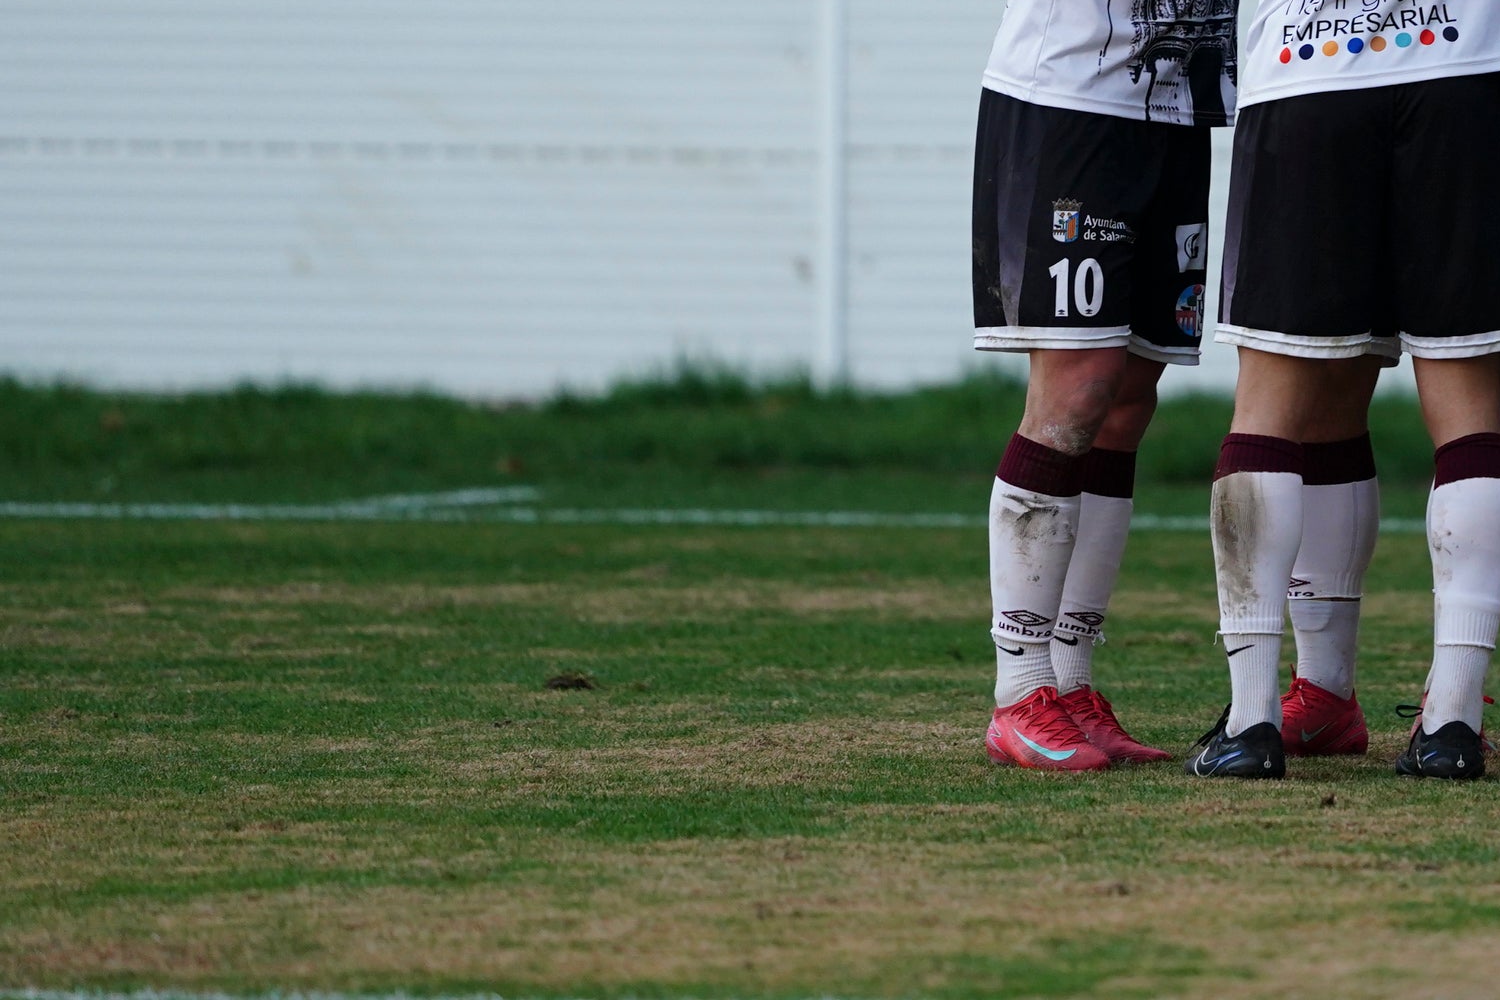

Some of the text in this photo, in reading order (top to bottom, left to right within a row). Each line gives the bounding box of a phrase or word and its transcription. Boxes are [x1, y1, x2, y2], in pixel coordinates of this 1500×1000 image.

[1282, 3, 1457, 45] EMPRESARIAL
[1083, 228, 1097, 241] de
[1048, 257, 1104, 318] 10
[998, 621, 1052, 638] umbro
